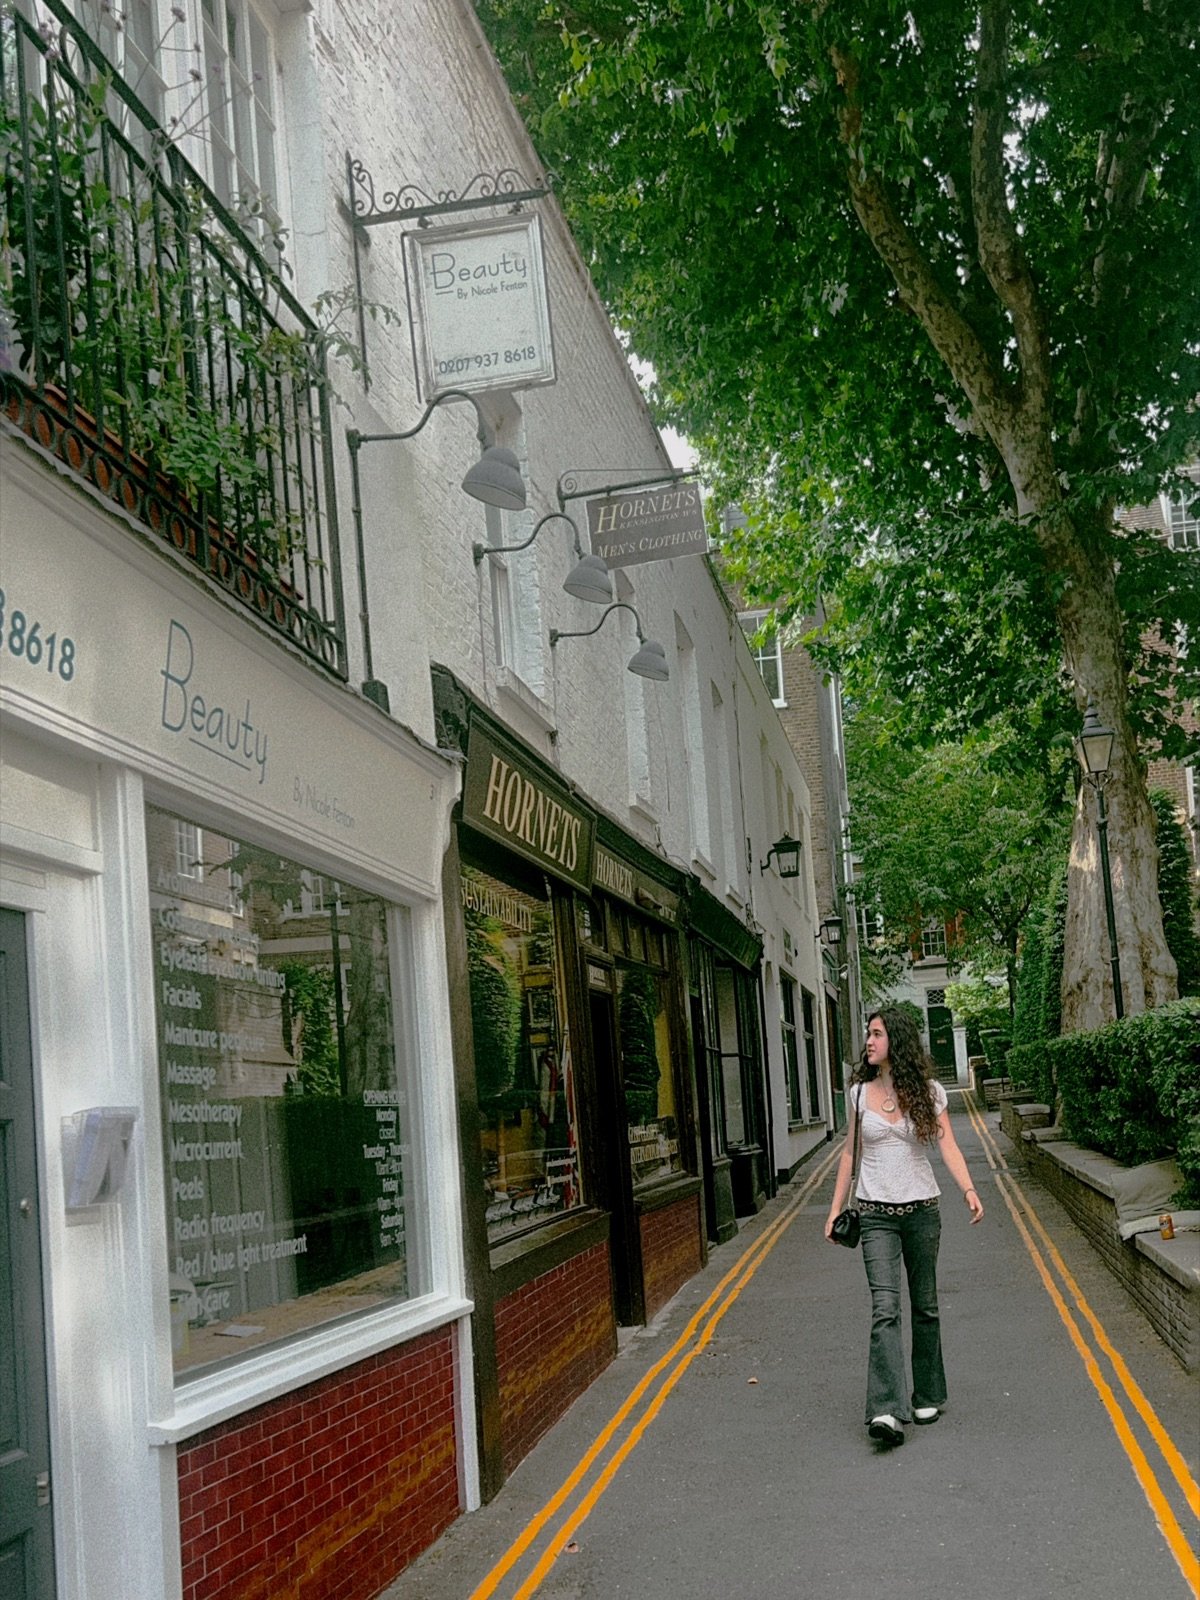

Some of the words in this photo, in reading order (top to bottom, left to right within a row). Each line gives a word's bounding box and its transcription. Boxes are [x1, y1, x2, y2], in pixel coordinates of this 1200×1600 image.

[430, 252, 527, 290] Beauty
[457, 288, 468, 300] By
[471, 283, 498, 297] Nicole
[439, 358, 471, 374] 0207
[474, 352, 499, 368] 937
[504, 346, 536, 364] 8618
[594, 488, 696, 534] HORNETS
[597, 541, 636, 559] MEN'S
[639, 529, 703, 551] CLOTHING
[0, 588, 75, 682] 8618
[160, 618, 269, 785] Beauty
[483, 753, 581, 872] HORNETS
[596, 850, 633, 898] HORNETS
[162, 980, 202, 1010] Facials
[164, 1020, 217, 1049] Manicure
[166, 1060, 217, 1091] Massage
[168, 1099, 242, 1127] Mesotherapy
[170, 1137, 243, 1162] Microcurrent
[172, 1175, 205, 1202] Peels
[174, 1213, 208, 1241] Radio
[210, 1210, 266, 1237] frequency
[176, 1253, 200, 1278] Red
[202, 1251, 208, 1276] /
[209, 1248, 235, 1273] blue
[237, 1242, 261, 1272] light
[261, 1233, 308, 1262] treatment
[207, 1289, 230, 1314] care
